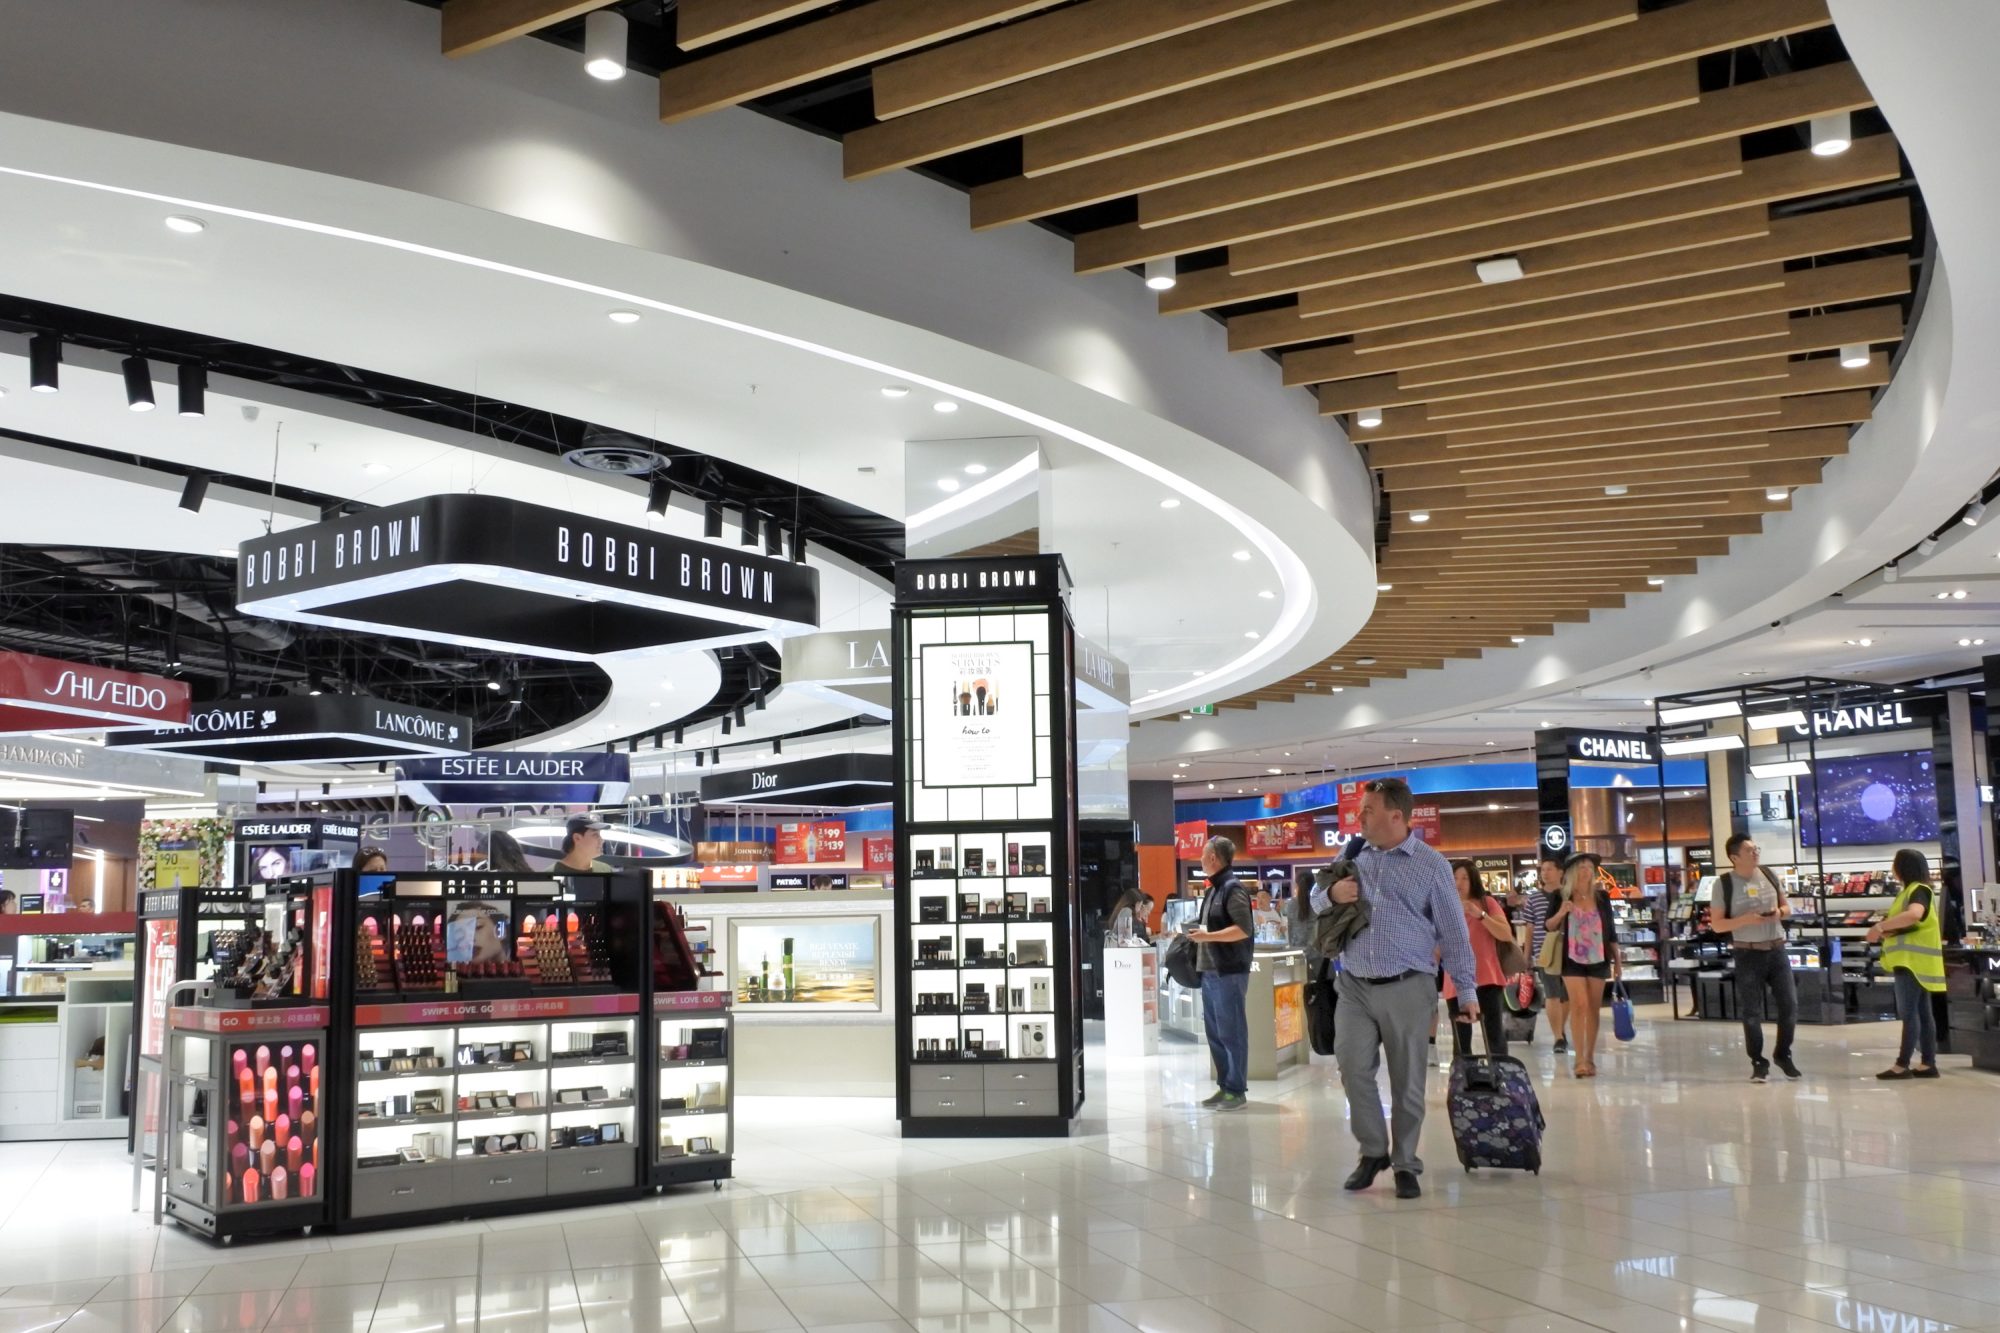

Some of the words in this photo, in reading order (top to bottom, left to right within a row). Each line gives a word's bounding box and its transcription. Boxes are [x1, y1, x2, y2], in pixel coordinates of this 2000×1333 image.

[246, 539, 316, 588] BOBBI
[335, 515, 420, 569] BROWN
[557, 526, 655, 580] BOBBI
[680, 553, 773, 604] BROWN
[916, 572, 968, 590] BOBBI
[979, 569, 1037, 588] BROWN
[45, 671, 166, 711] SHISEIDO
[375, 710, 445, 741] LANCÔME
[1579, 736, 1653, 760] CHANEL
[505, 759, 585, 776] LAUDER
[752, 772, 778, 790] Dior
[1411, 808, 1436, 816] FREE
[272, 824, 311, 834] LAUDER
